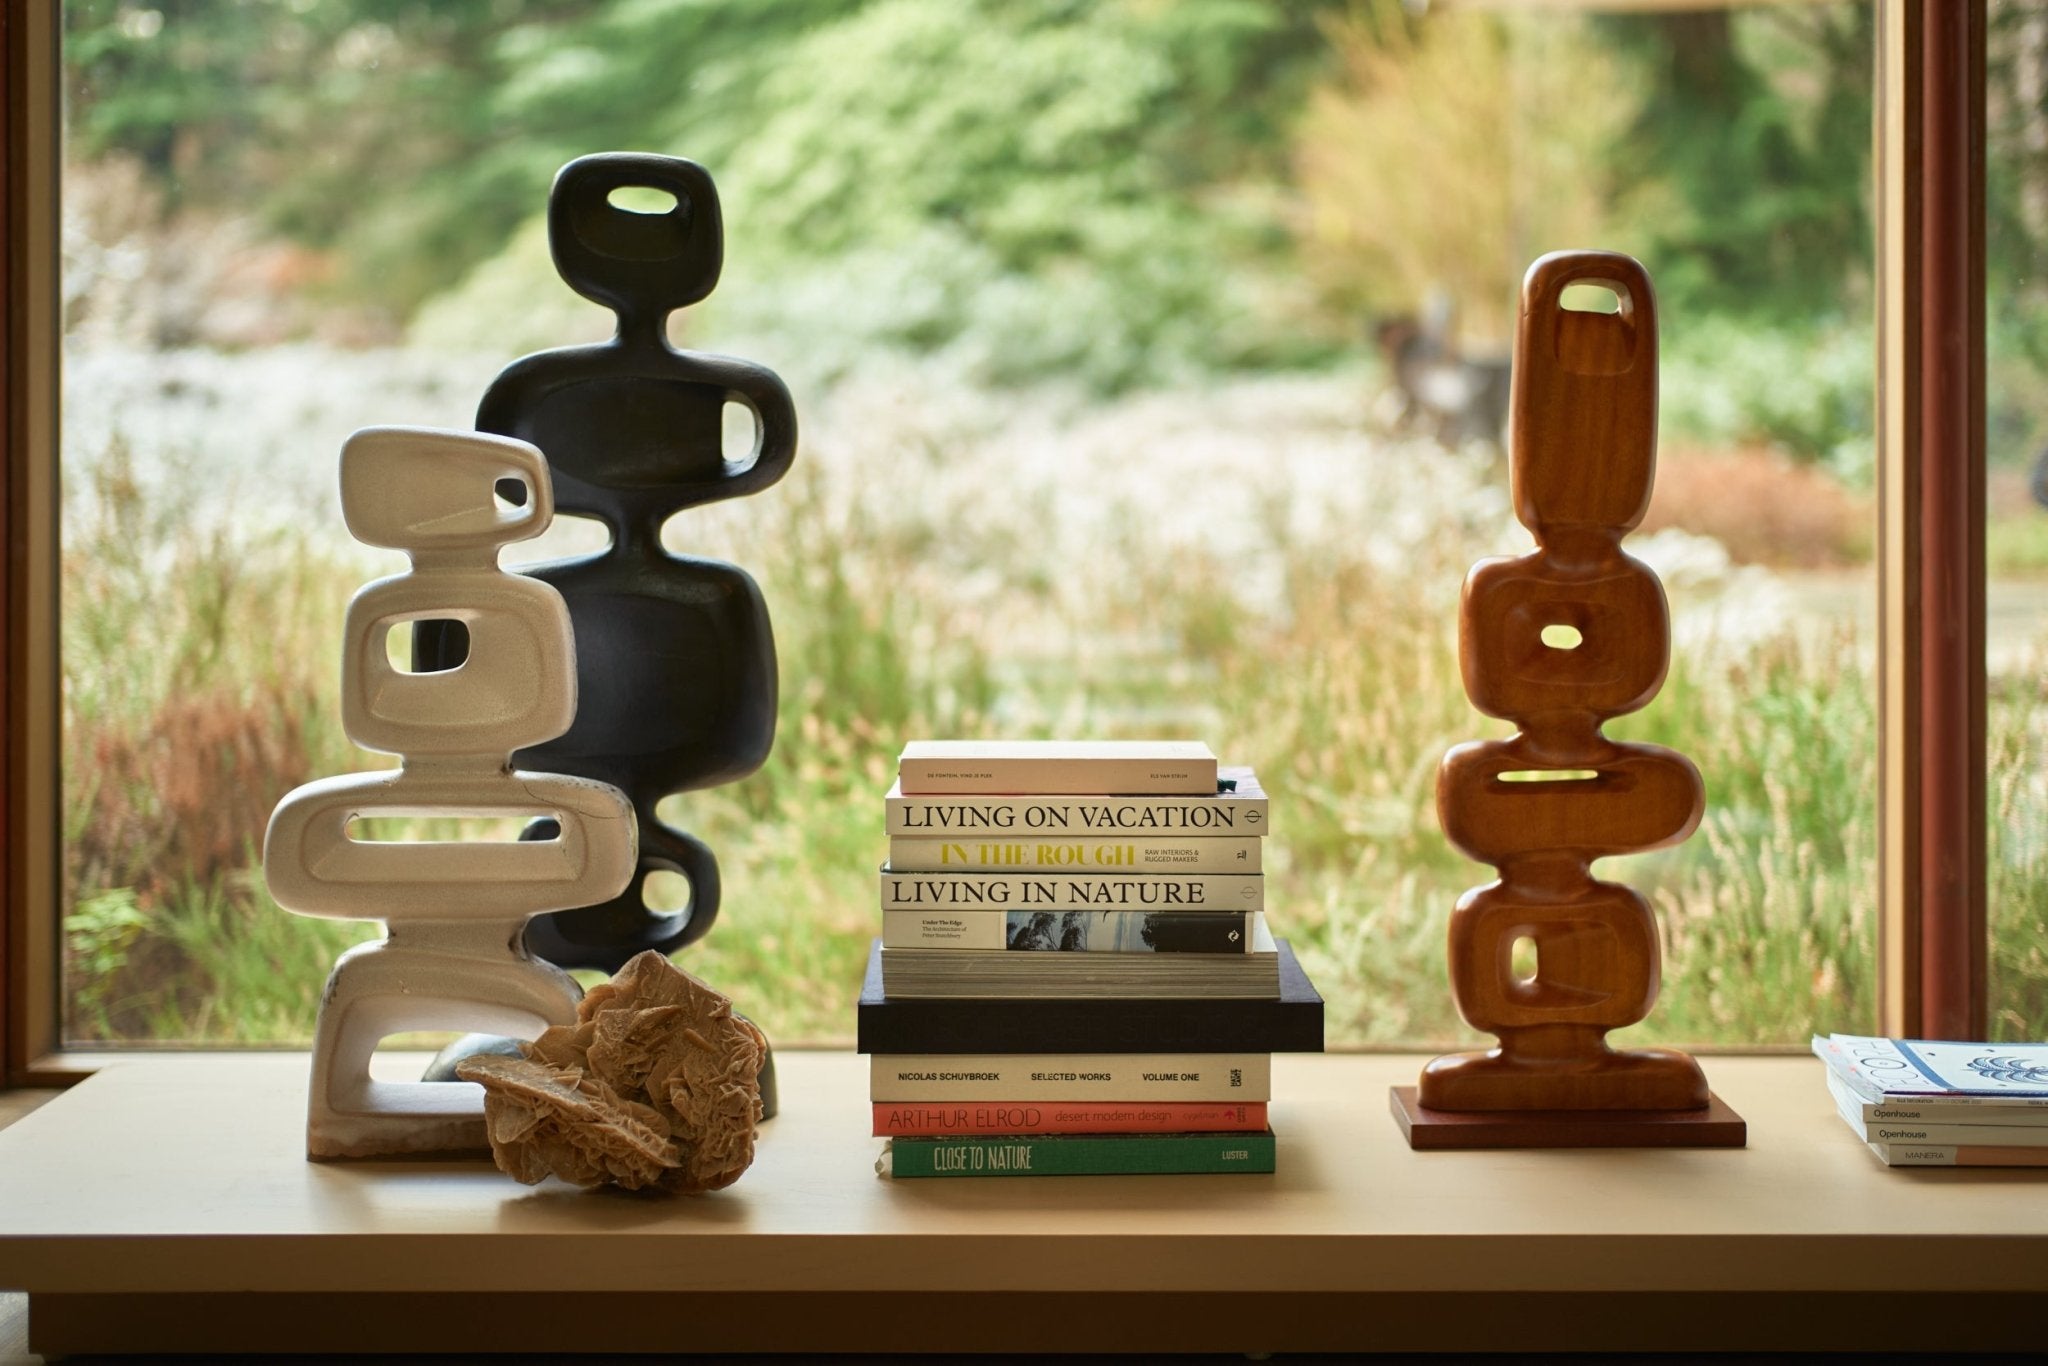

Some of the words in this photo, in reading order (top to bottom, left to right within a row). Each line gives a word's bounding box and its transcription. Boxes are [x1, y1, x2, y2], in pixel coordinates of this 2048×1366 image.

[903, 806, 1015, 827] LIVING
[1025, 806, 1069, 828] ON
[1079, 806, 1234, 828] VACATION
[941, 844, 969, 865] IN
[976, 844, 1030, 865] THE
[1037, 844, 1135, 865] ROUGH
[892, 881, 1011, 904] LIVING
[1021, 881, 1056, 904] IN
[1068, 882, 1205, 904] NATURE
[898, 1073, 937, 1081] NICOLAS
[939, 1073, 999, 1081] SCHUYBROEK
[1031, 1073, 1077, 1081] SELECTED
[1079, 1073, 1111, 1081] WORKS
[1142, 1073, 1178, 1081] VOLUME
[1180, 1073, 1199, 1081] ONE
[888, 1109, 969, 1128] ARTHUR
[976, 1108, 1041, 1128] ELROD
[1055, 1108, 1090, 1122] desert
[1093, 1109, 1134, 1121] modern
[1138, 1109, 1172, 1123] design
[1874, 1109, 1921, 1119] Openhouse
[1879, 1129, 1927, 1139] Openhouse
[934, 1145, 967, 1170] CLOSE
[969, 1145, 983, 1170] TO
[988, 1145, 1032, 1170] NATURE
[1222, 1150, 1248, 1160] LUSTER
[1905, 1151, 1944, 1159] MANERA
